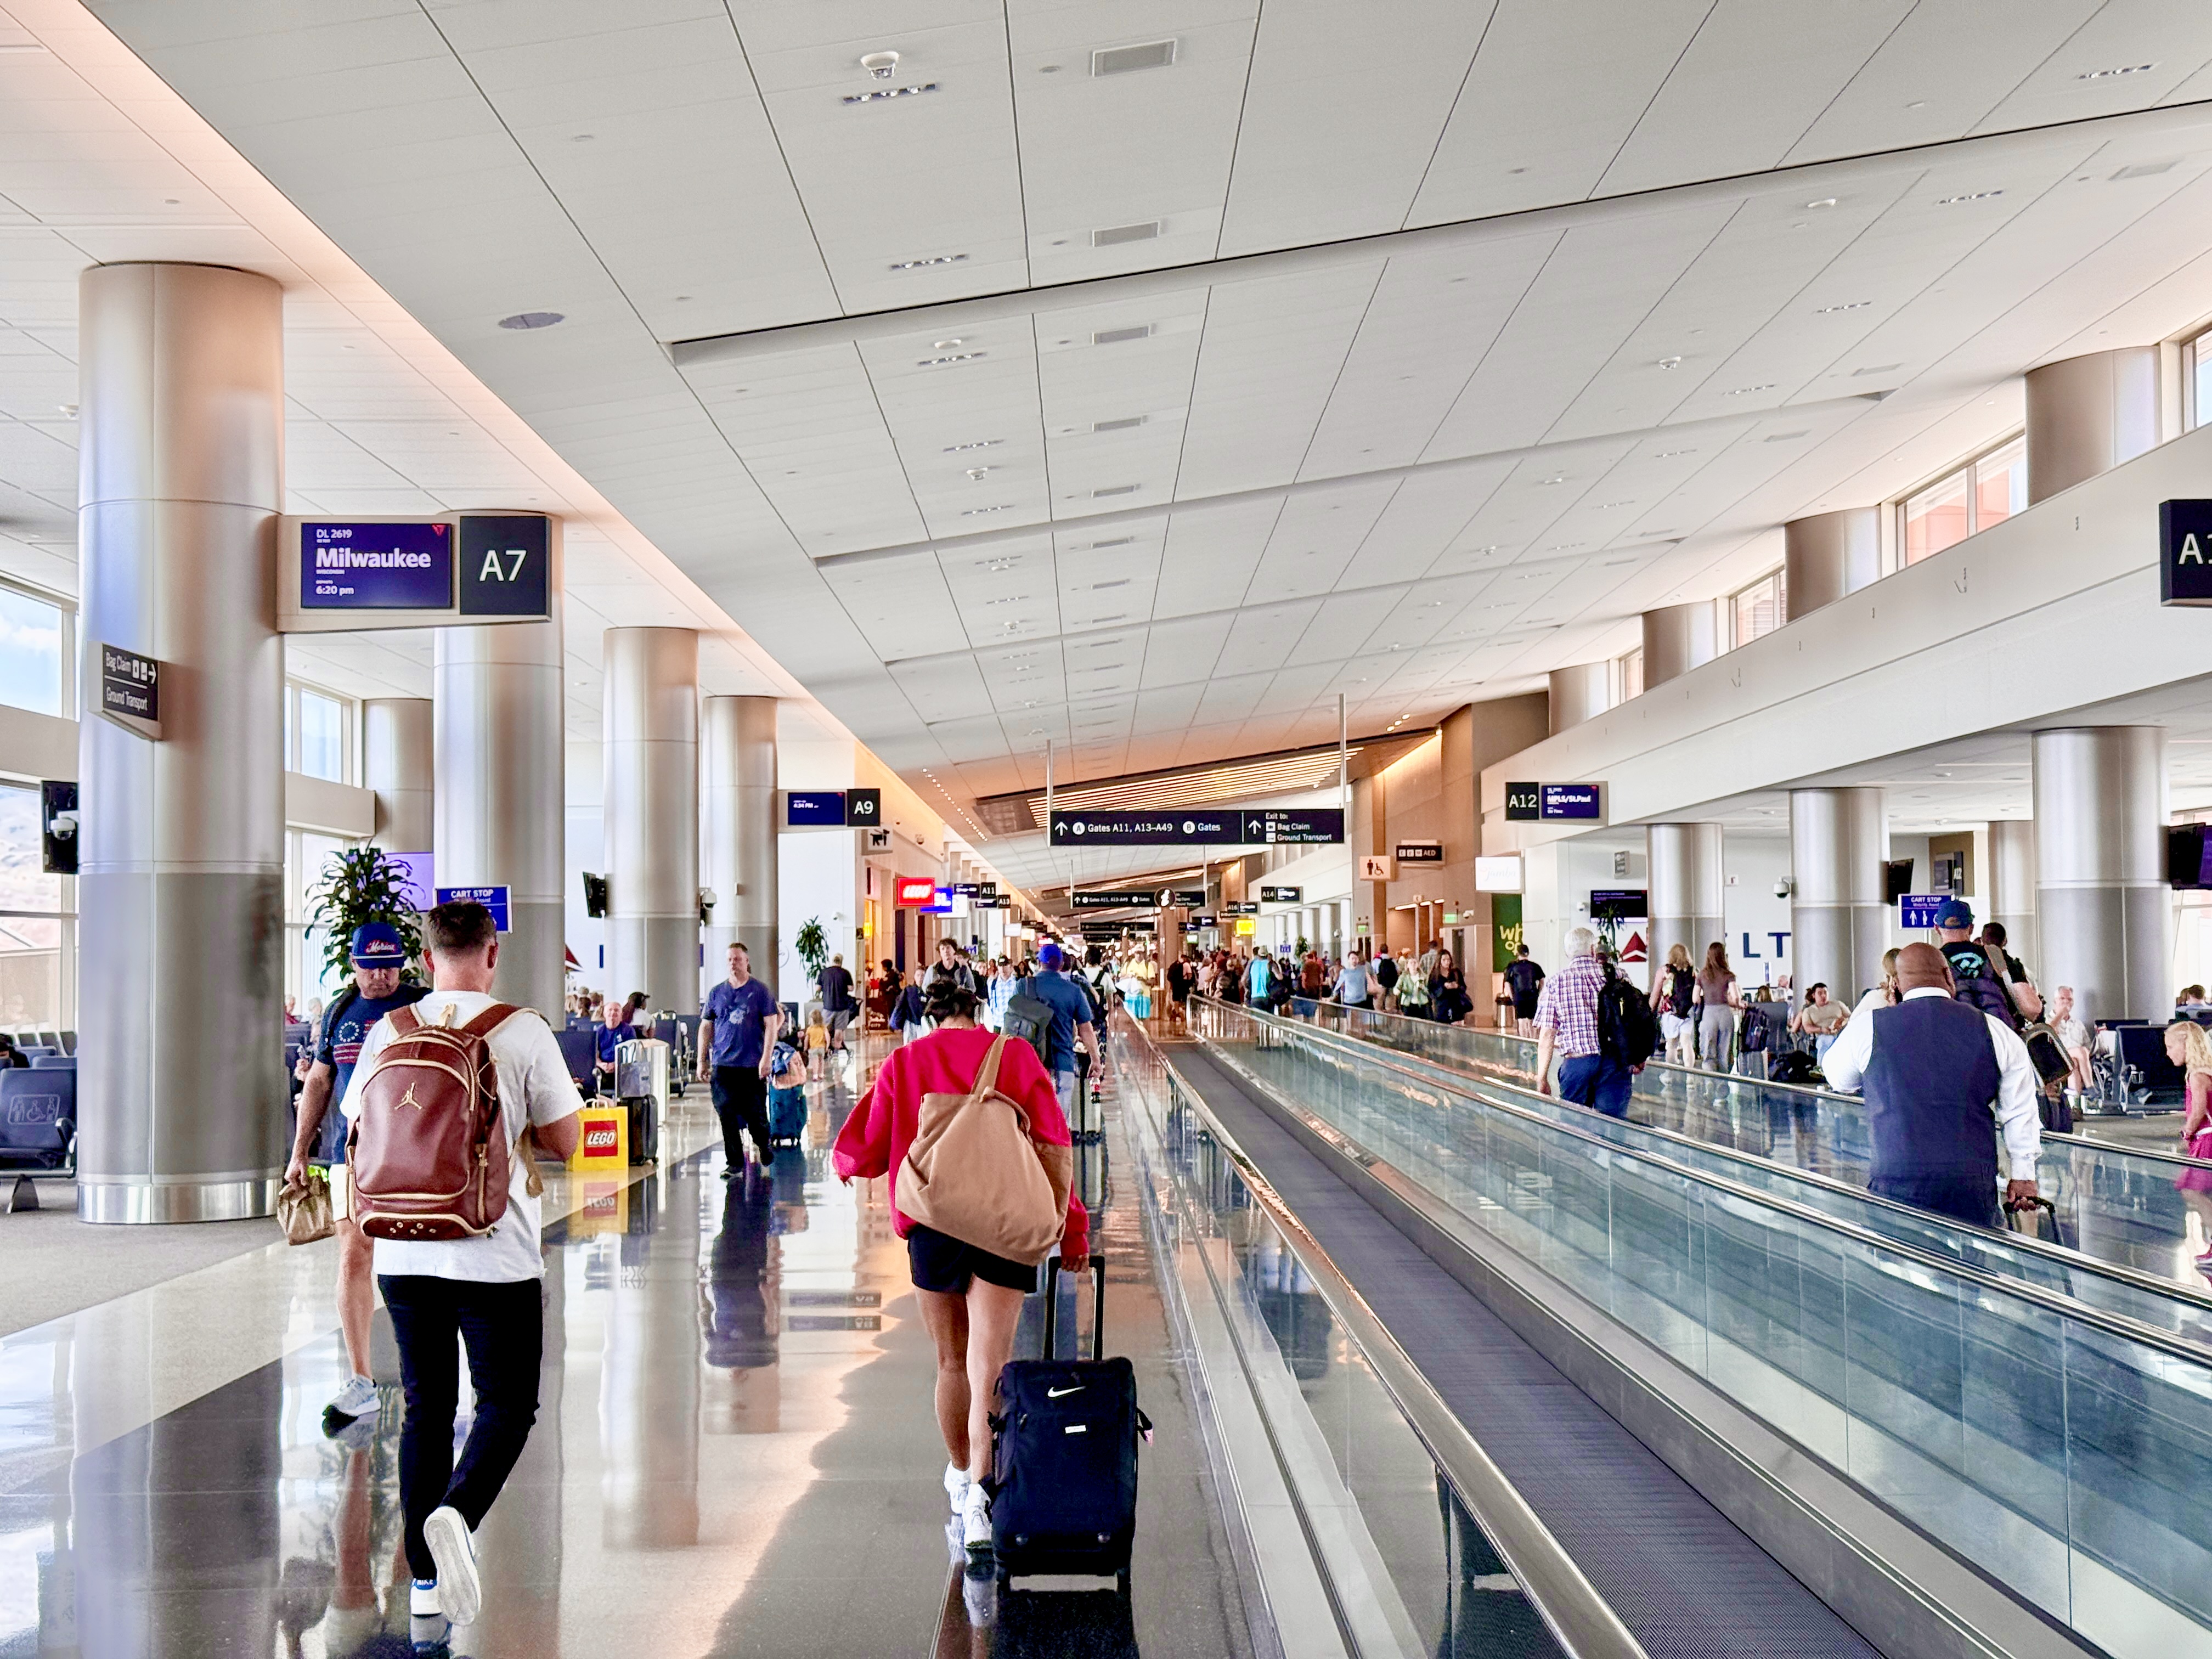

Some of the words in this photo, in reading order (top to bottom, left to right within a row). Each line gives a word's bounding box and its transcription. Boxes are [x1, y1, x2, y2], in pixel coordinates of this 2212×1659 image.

[316, 529, 329, 538] DL
[330, 529, 352, 538] 2619
[2178, 533, 2212, 565] A
[316, 548, 431, 568] Milwaukee
[479, 550, 527, 582] A7
[315, 585, 337, 595] 6:20
[339, 586, 354, 596] pm
[106, 652, 116, 672] Bag
[117, 654, 131, 673] Claim
[106, 686, 125, 705] Ground
[125, 691, 148, 712] Transport
[854, 800, 873, 815] A9
[1509, 794, 1537, 808] A12
[1087, 823, 1110, 832] Gates
[1113, 823, 1132, 833] A11,
[1198, 823, 1221, 832] Gates
[1277, 823, 1290, 832] Bag
[1302, 833, 1332, 842] Transport
[1485, 866, 1516, 882] jamba
[450, 890, 472, 898] CART
[473, 889, 494, 898] STOP
[902, 884, 932, 899] LEGO
[934, 893, 951, 907] SL
[586, 1131, 615, 1146] LEGO
